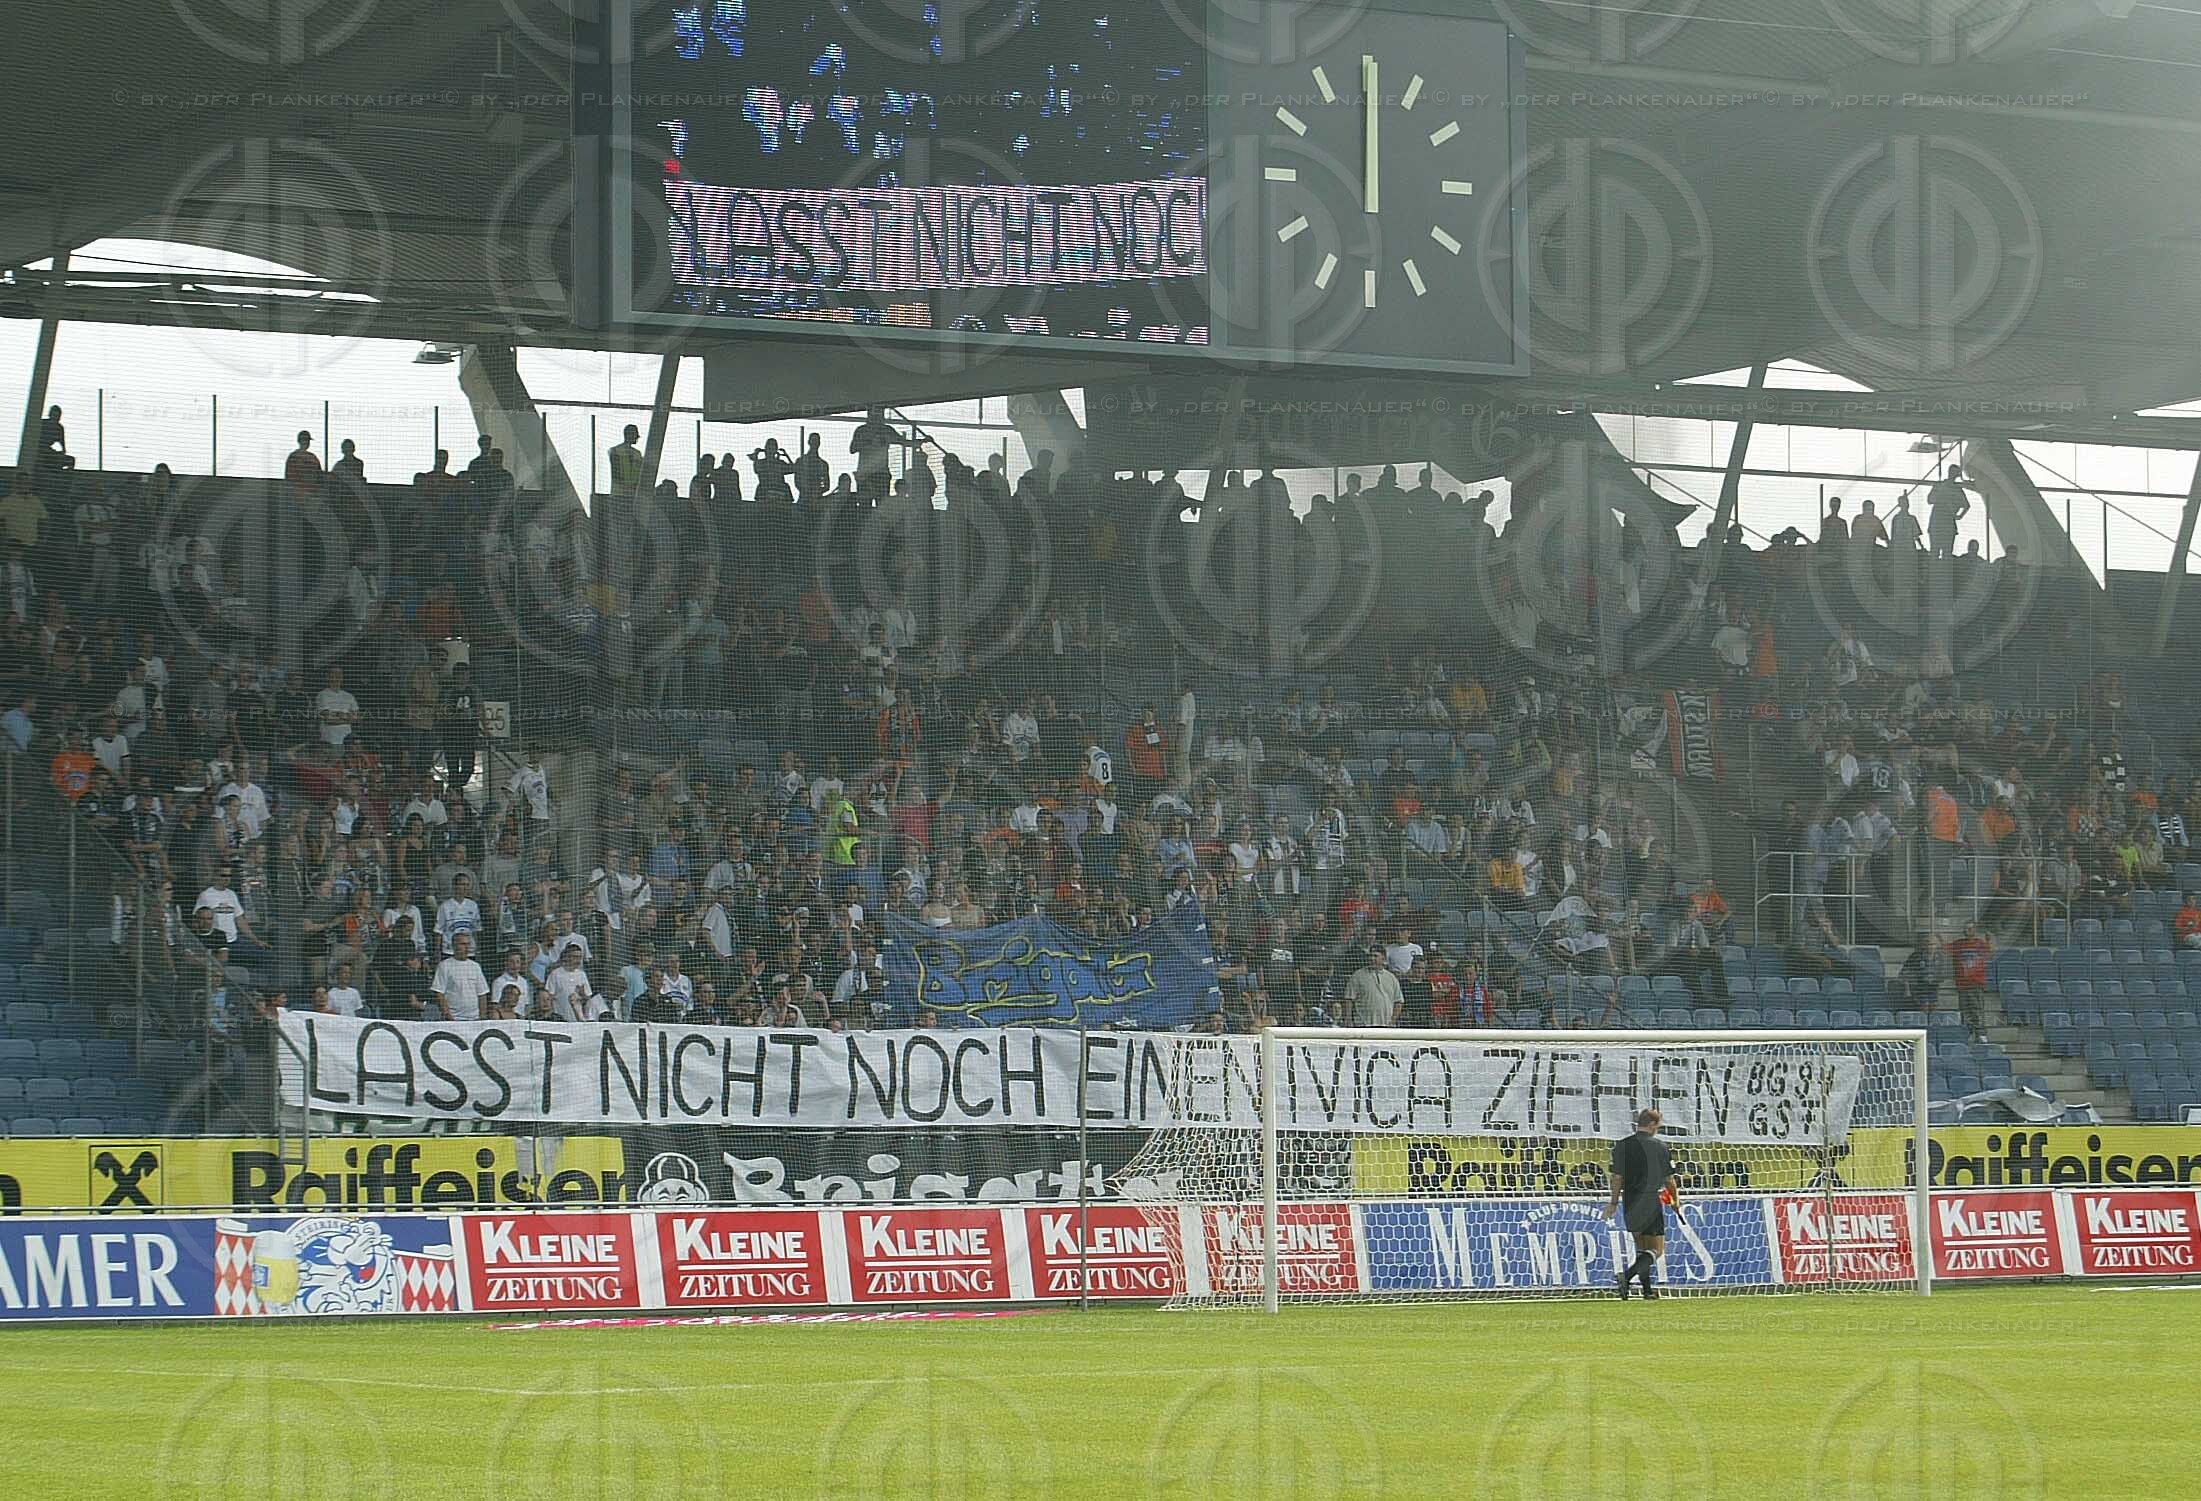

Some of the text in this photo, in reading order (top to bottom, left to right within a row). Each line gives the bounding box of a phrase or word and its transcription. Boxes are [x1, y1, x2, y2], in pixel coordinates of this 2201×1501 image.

[915, 192, 1073, 284] NICHT
[1094, 186, 1207, 275] NOC
[306, 1018, 1736, 1137] LASST NICHT NOCH EINEN IVICA ZIEHEN
[1407, 1137, 1750, 1191] Raiffeen
[1527, 1204, 1559, 1222] BLUE
[1786, 1202, 1897, 1241] KLEINE
[1937, 1199, 2046, 1237] KLEINE
[2085, 1196, 2190, 1235] KLEINE
[482, 1221, 620, 1264] KLEINE
[671, 1218, 807, 1261] KLEINE
[858, 1214, 991, 1258] KLEINE
[1039, 1213, 1168, 1255] KLEINE
[1424, 1203, 1713, 1288] MEMPHIS
[1793, 1252, 1901, 1275] ZEITUNG
[1944, 1246, 2050, 1271] ZEITUNG
[2093, 1244, 2194, 1268] ZEITUNG
[486, 1276, 624, 1302] ZEITUNG
[678, 1270, 811, 1299] ZEITUNG
[865, 1266, 995, 1295] ZEITUNG
[1047, 1265, 1172, 1293] ZEITUNG
